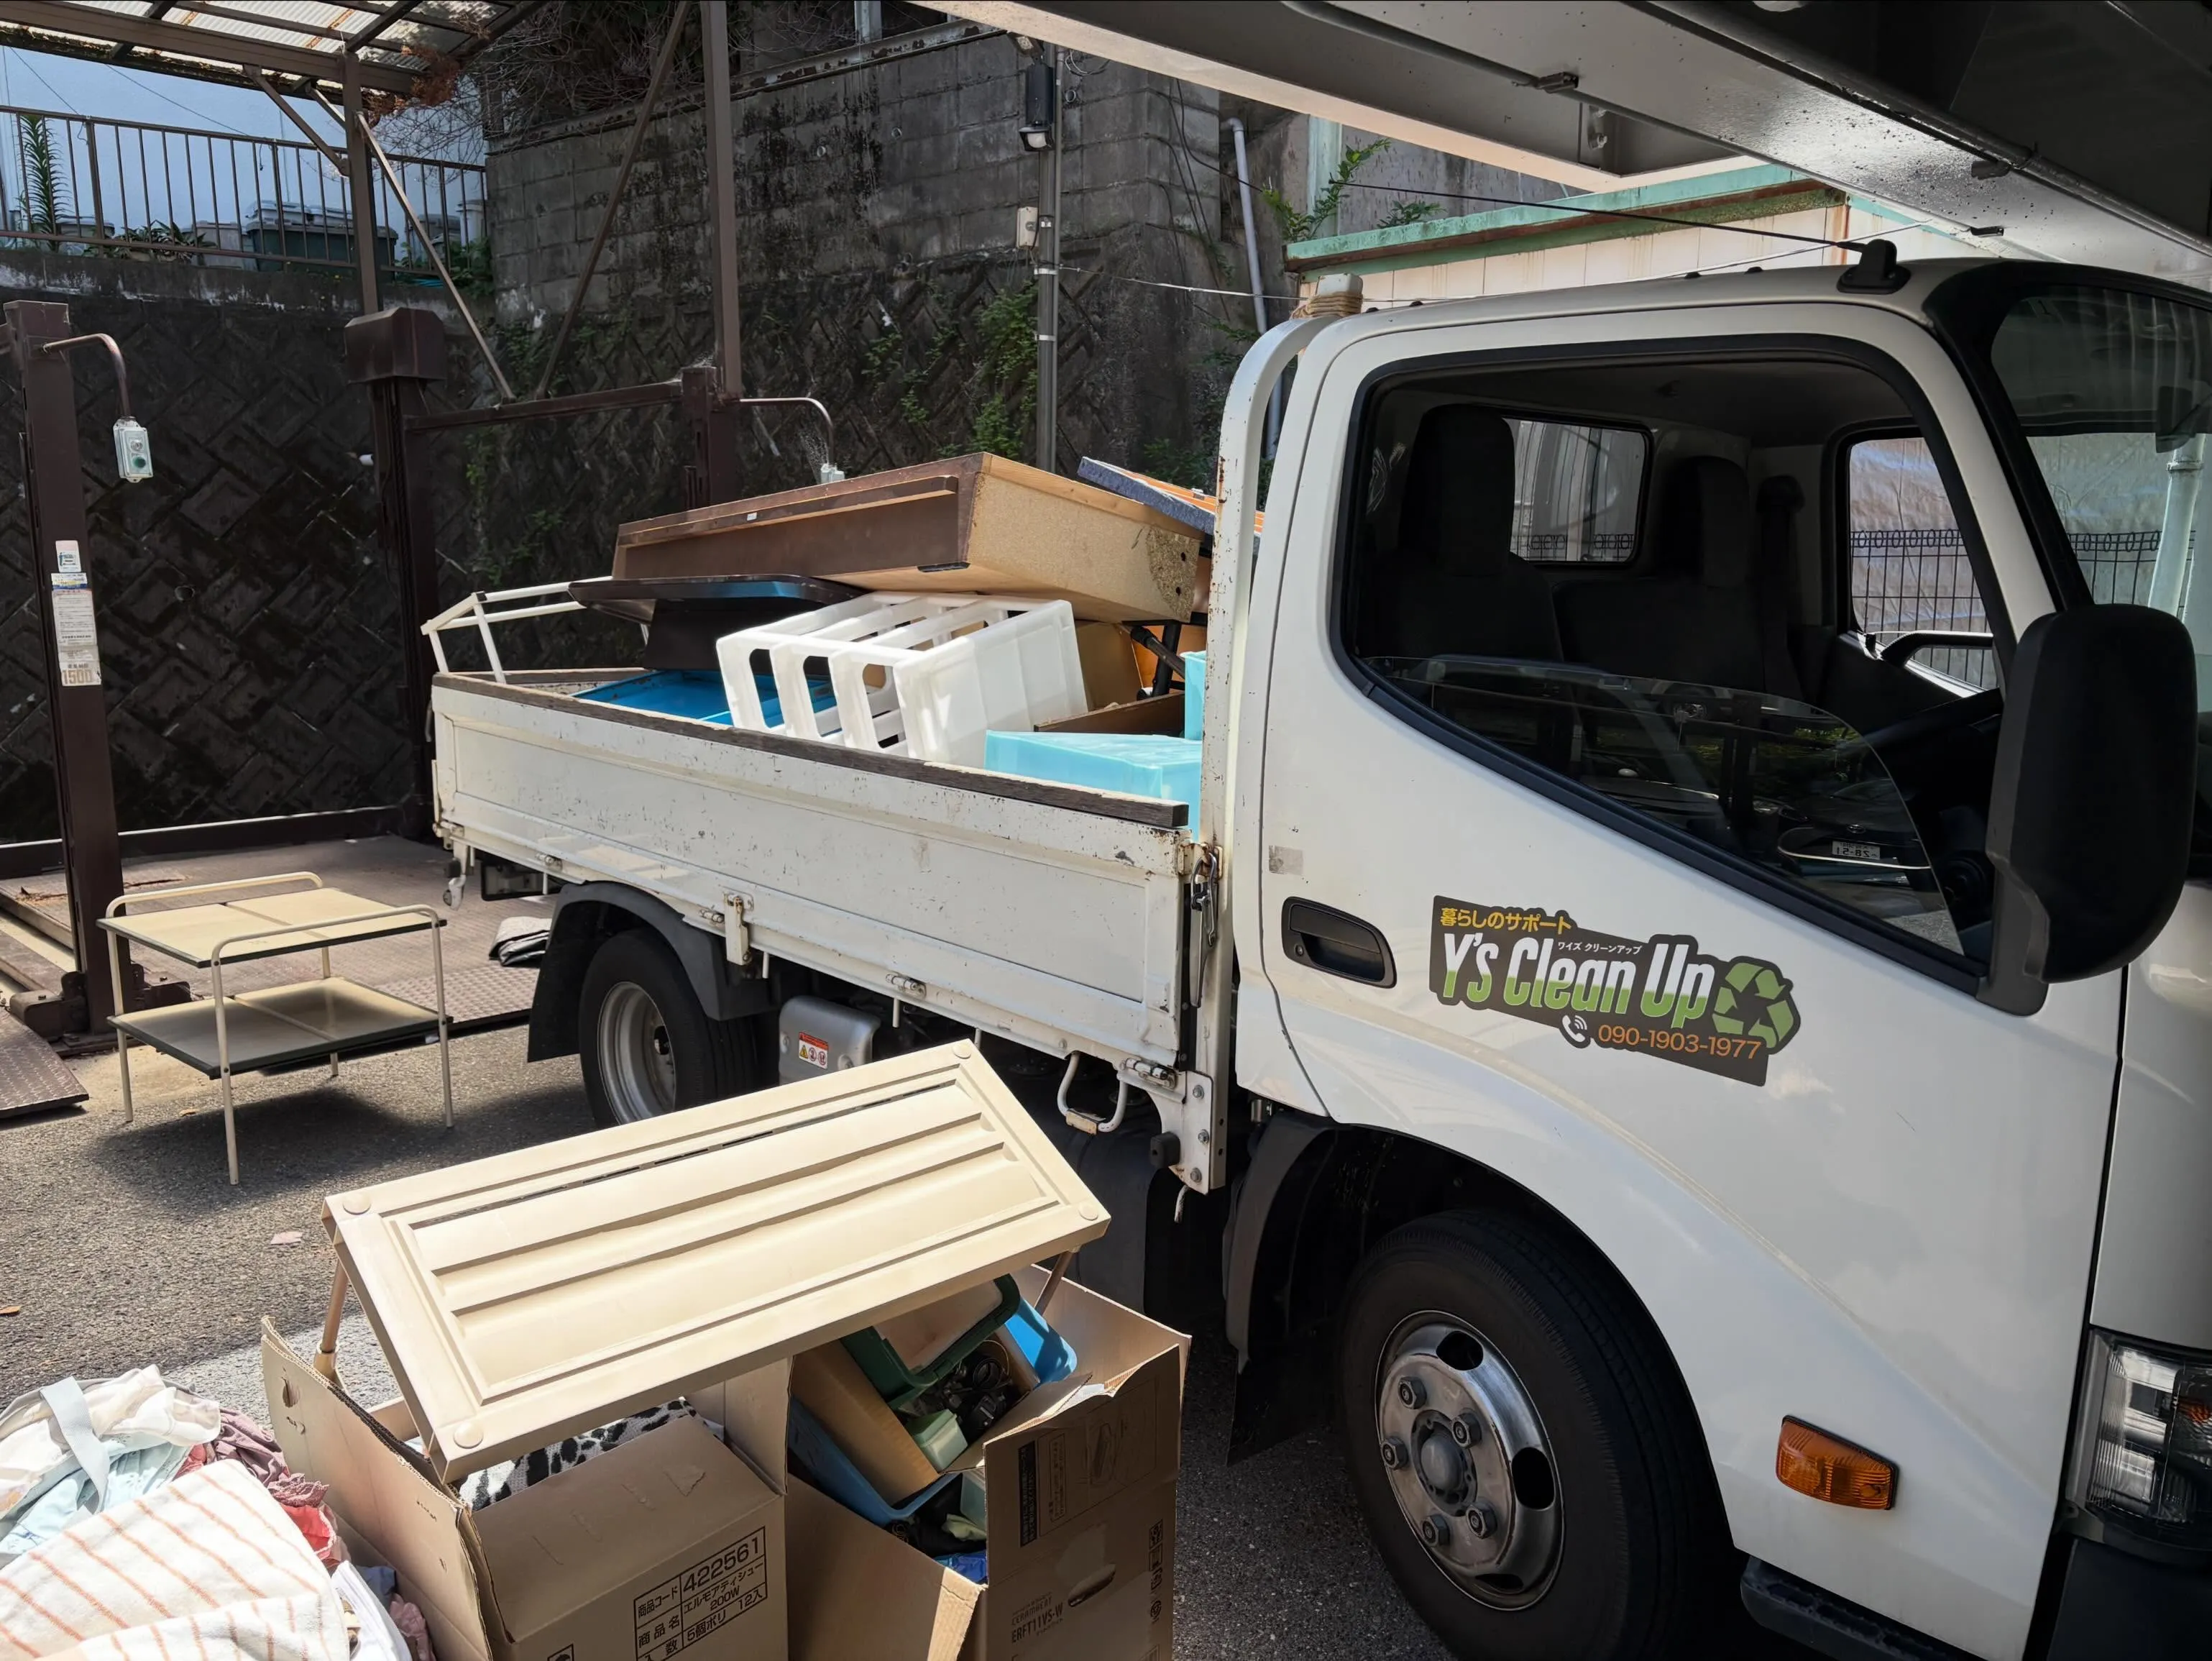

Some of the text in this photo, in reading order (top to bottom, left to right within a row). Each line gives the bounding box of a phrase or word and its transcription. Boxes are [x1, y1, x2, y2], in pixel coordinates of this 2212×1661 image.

[1440, 907, 1571, 935] 暮らしのサポート
[1558, 942, 1642, 955] ワイズ クリーンアップ
[1443, 933, 1715, 1029] Y's Clean Up
[1598, 1025, 1761, 1059] 090-1903-1977
[683, 1537, 758, 1593] 422561
[638, 1586, 678, 1619] 商品コード
[684, 1562, 763, 1614] エルモアティシュー
[710, 1586, 740, 1611] 200W
